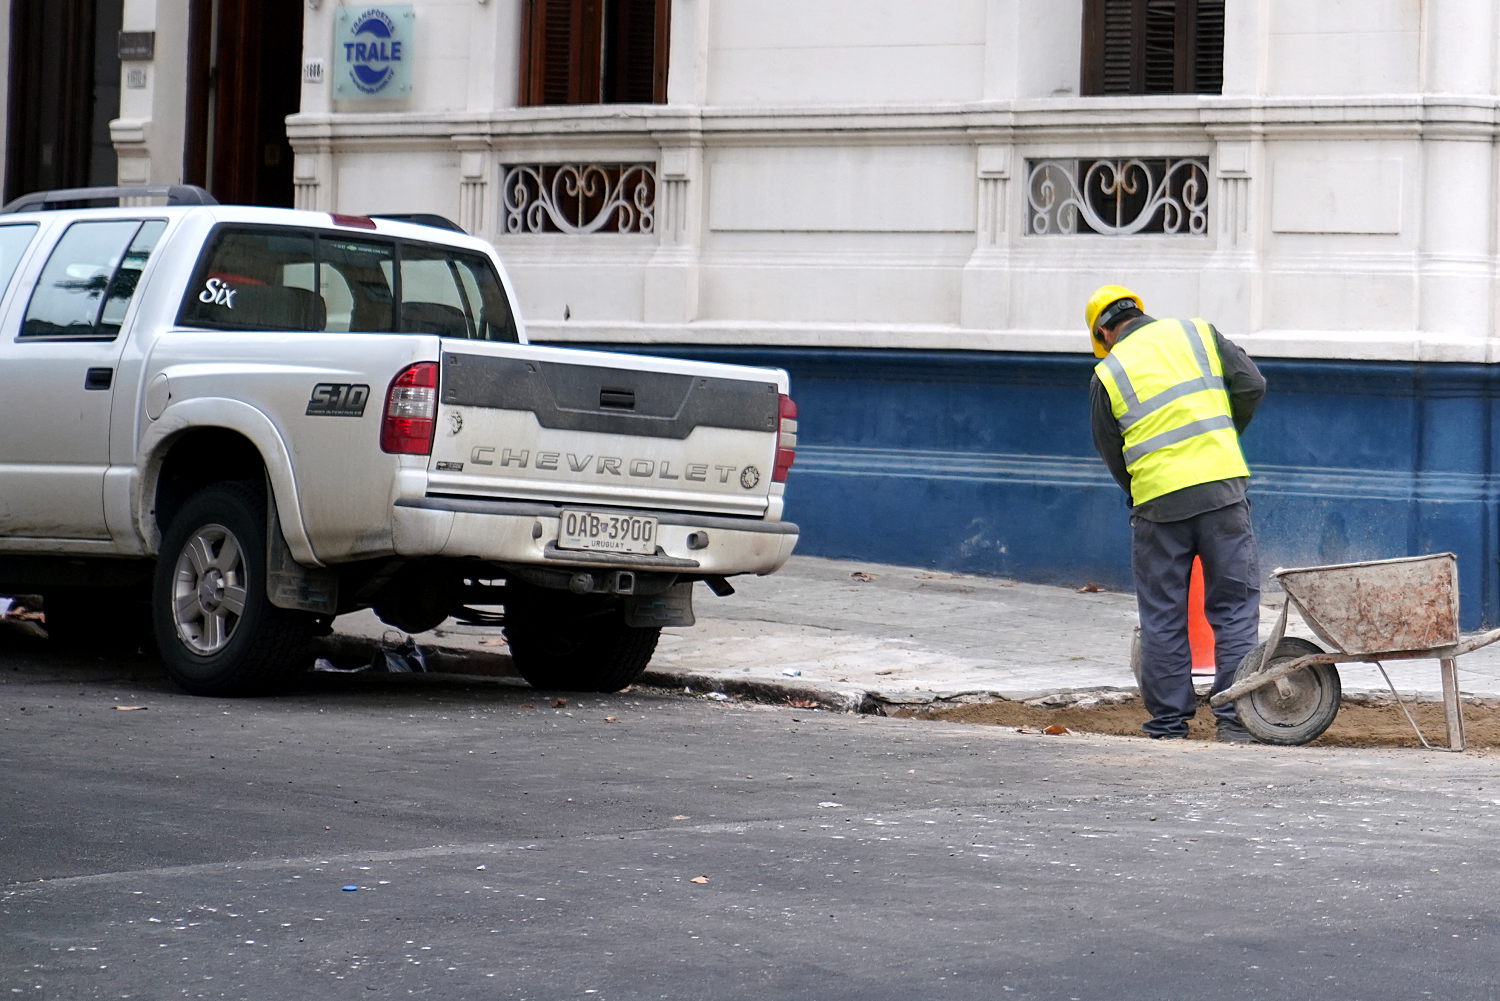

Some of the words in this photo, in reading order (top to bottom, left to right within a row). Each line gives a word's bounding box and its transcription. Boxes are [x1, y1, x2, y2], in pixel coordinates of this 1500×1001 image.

[351, 8, 395, 34] TRANSPORTES
[343, 41, 402, 62] TRALE
[199, 277, 237, 309] Six
[470, 446, 736, 483] CHEVROLET
[566, 513, 600, 538] OAB
[608, 517, 653, 541] 3900
[591, 540, 625, 549] URUGUAY
